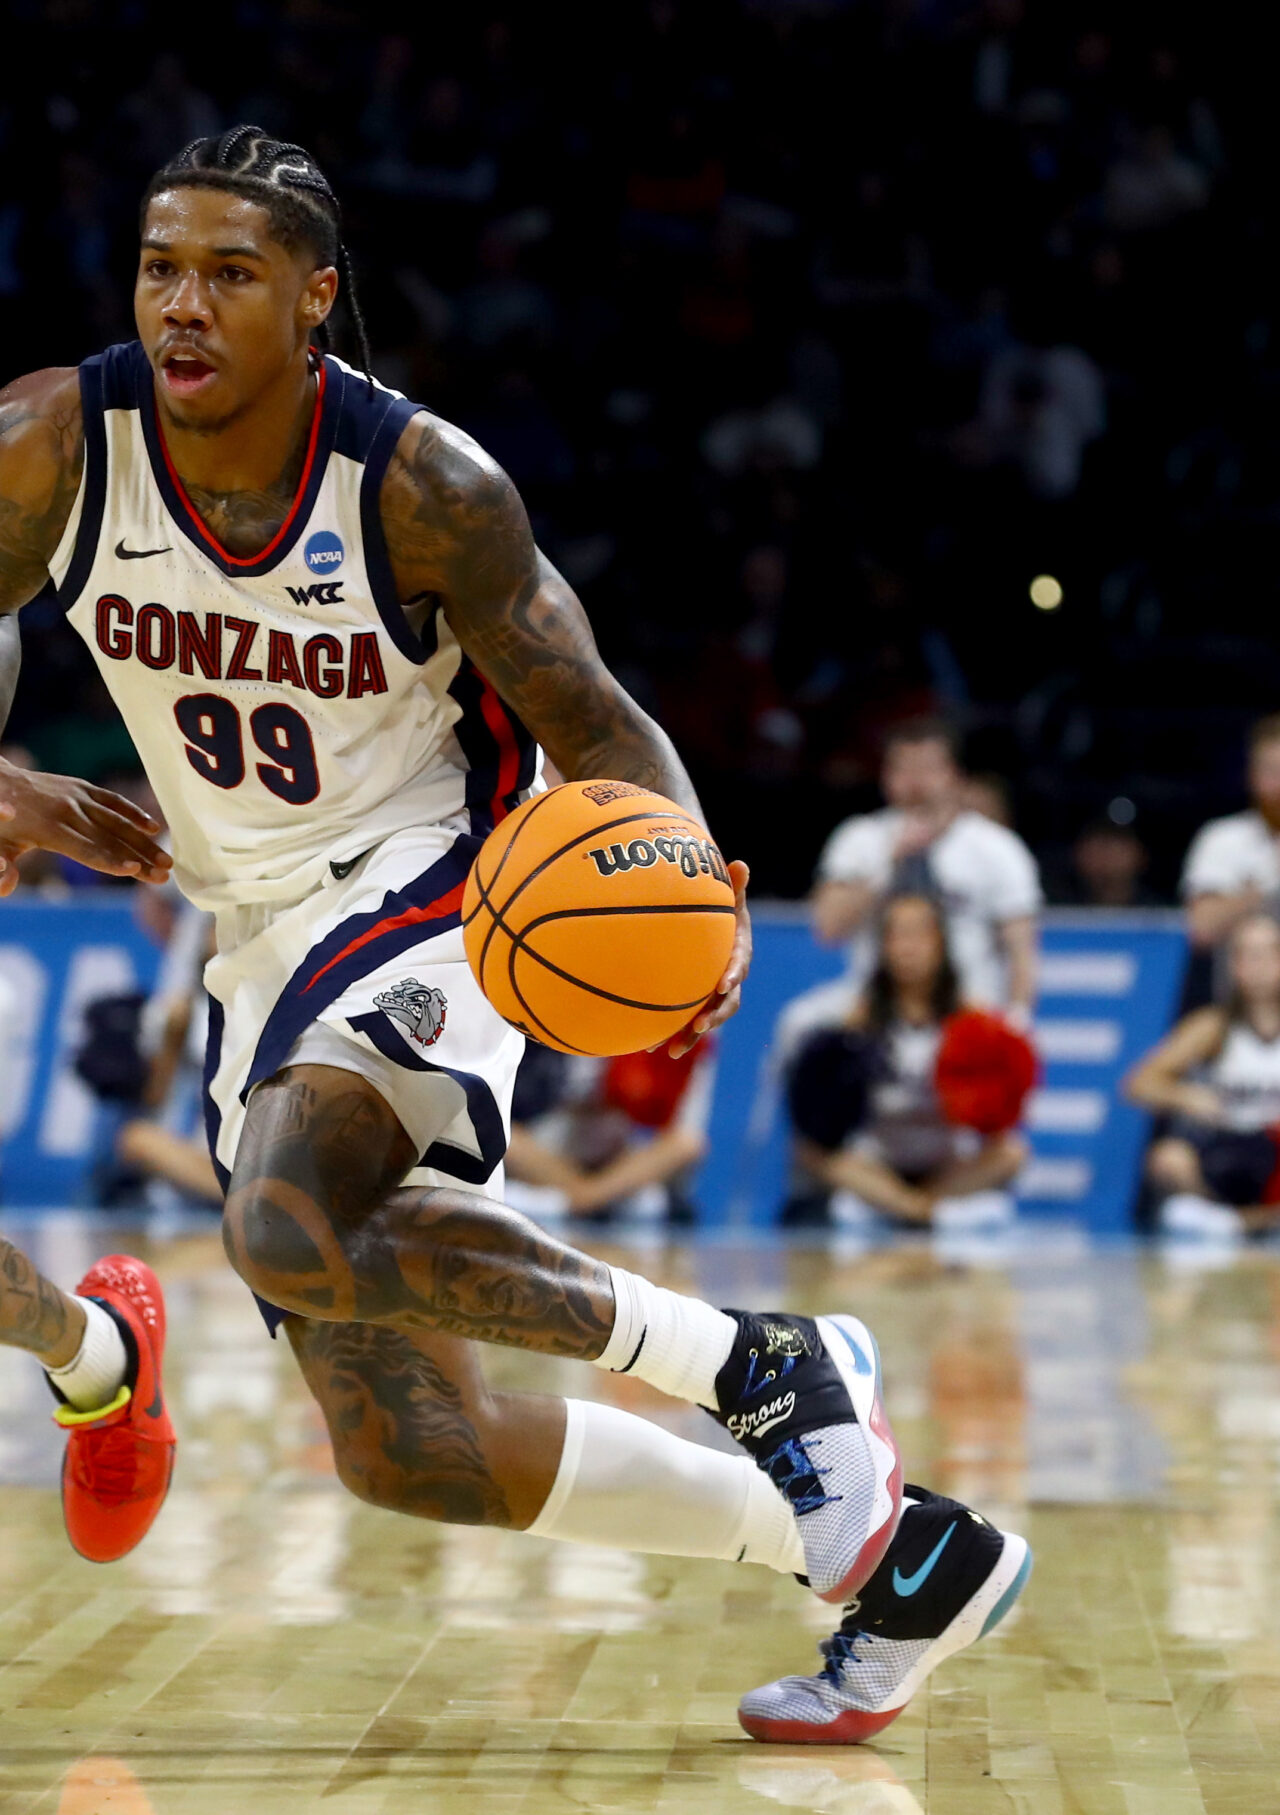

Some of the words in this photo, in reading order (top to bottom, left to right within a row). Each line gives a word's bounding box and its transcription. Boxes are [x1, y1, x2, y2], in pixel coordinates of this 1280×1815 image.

[310, 550, 342, 565] NCAA
[285, 581, 345, 607] WCC
[95, 593, 389, 700] GONZAGA
[173, 692, 321, 806] 99
[587, 834, 732, 889] Wilson
[726, 1390, 796, 1441] Strong
